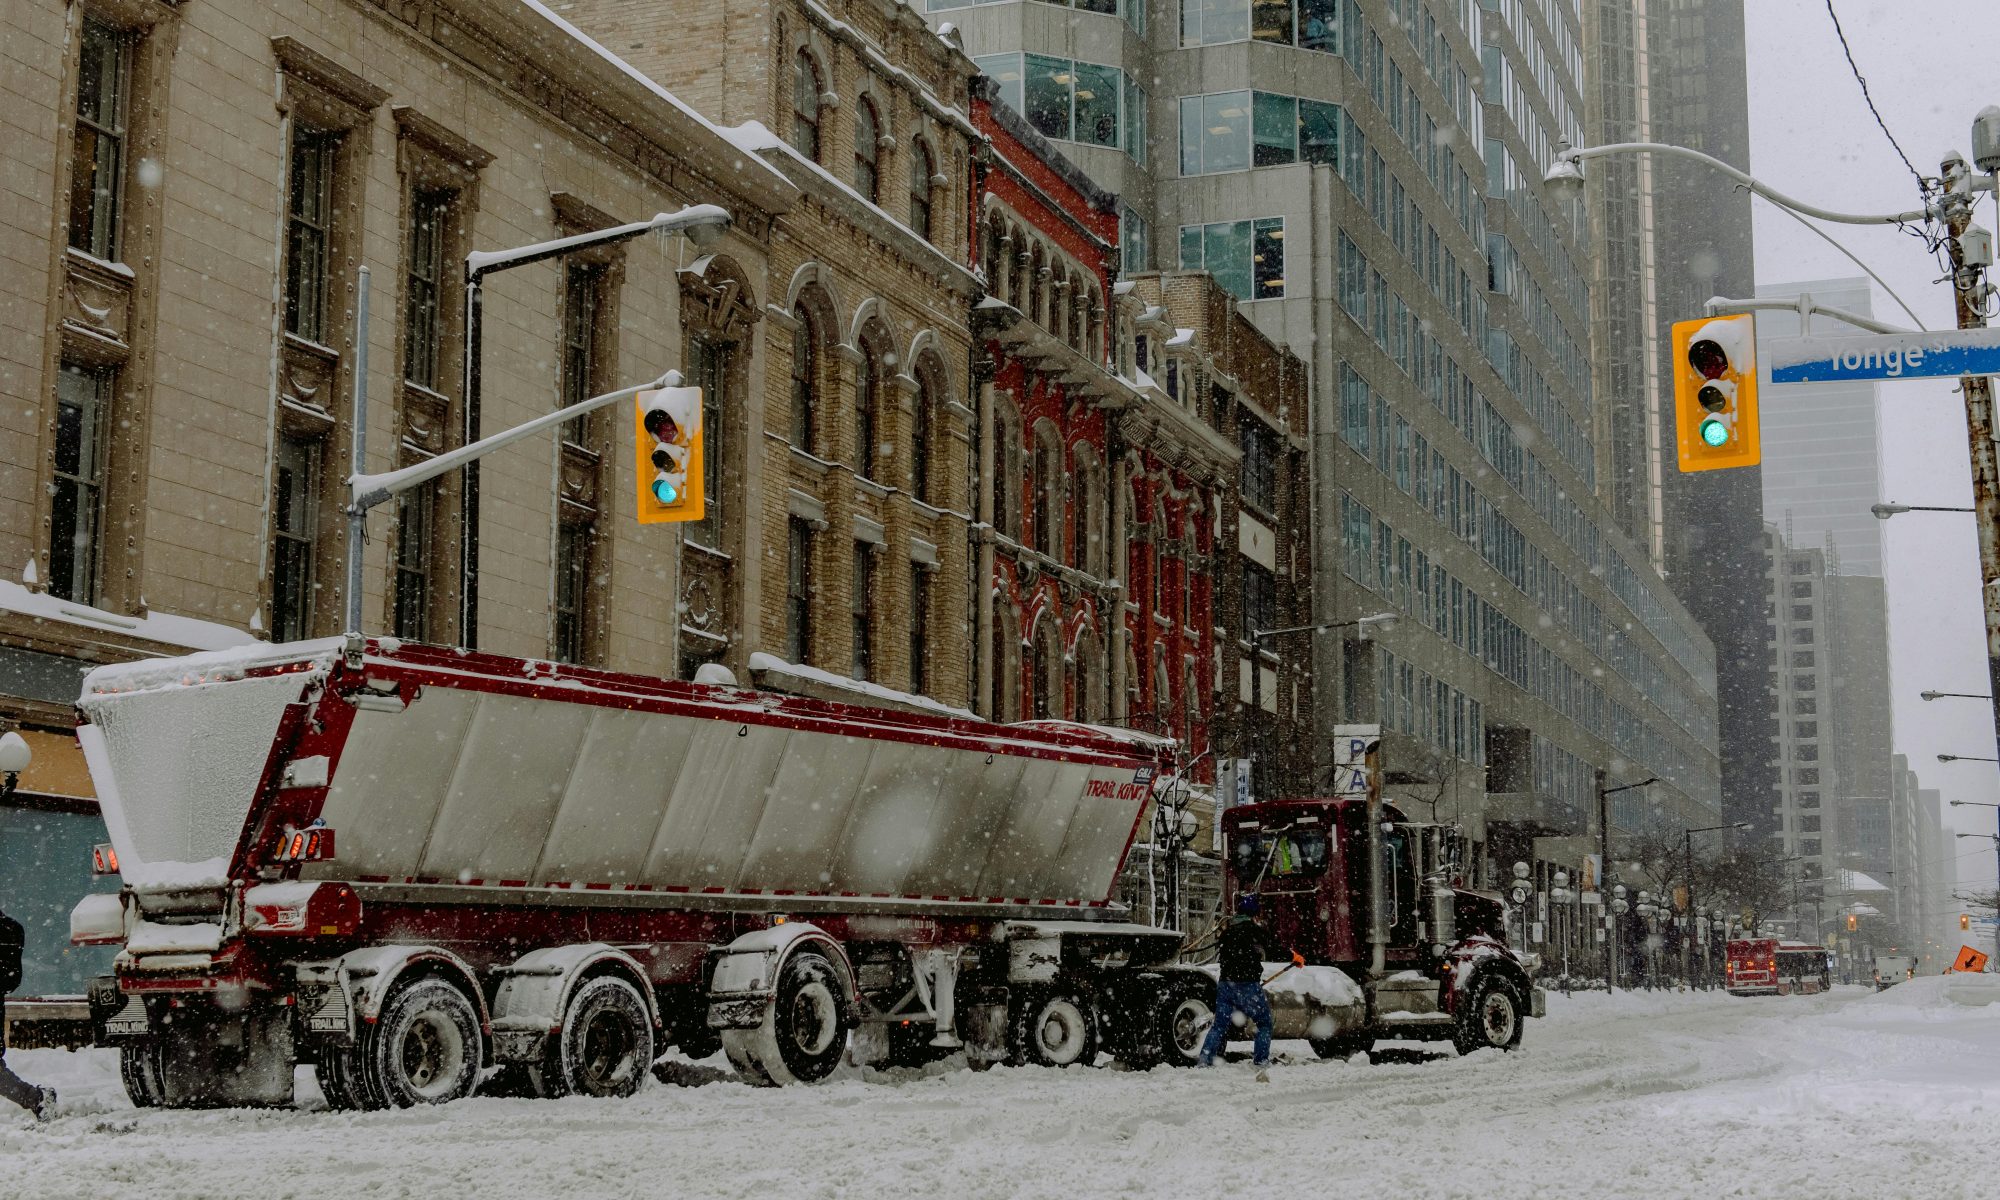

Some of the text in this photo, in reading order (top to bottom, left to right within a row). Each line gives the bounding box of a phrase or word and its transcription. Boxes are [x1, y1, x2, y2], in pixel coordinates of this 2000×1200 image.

[1828, 342, 1924, 376] Yonge
[1086, 780, 1145, 800] TRAIL KING
[104, 1021, 130, 1033] TRAIL
[309, 1018, 332, 1030] TRAIL
